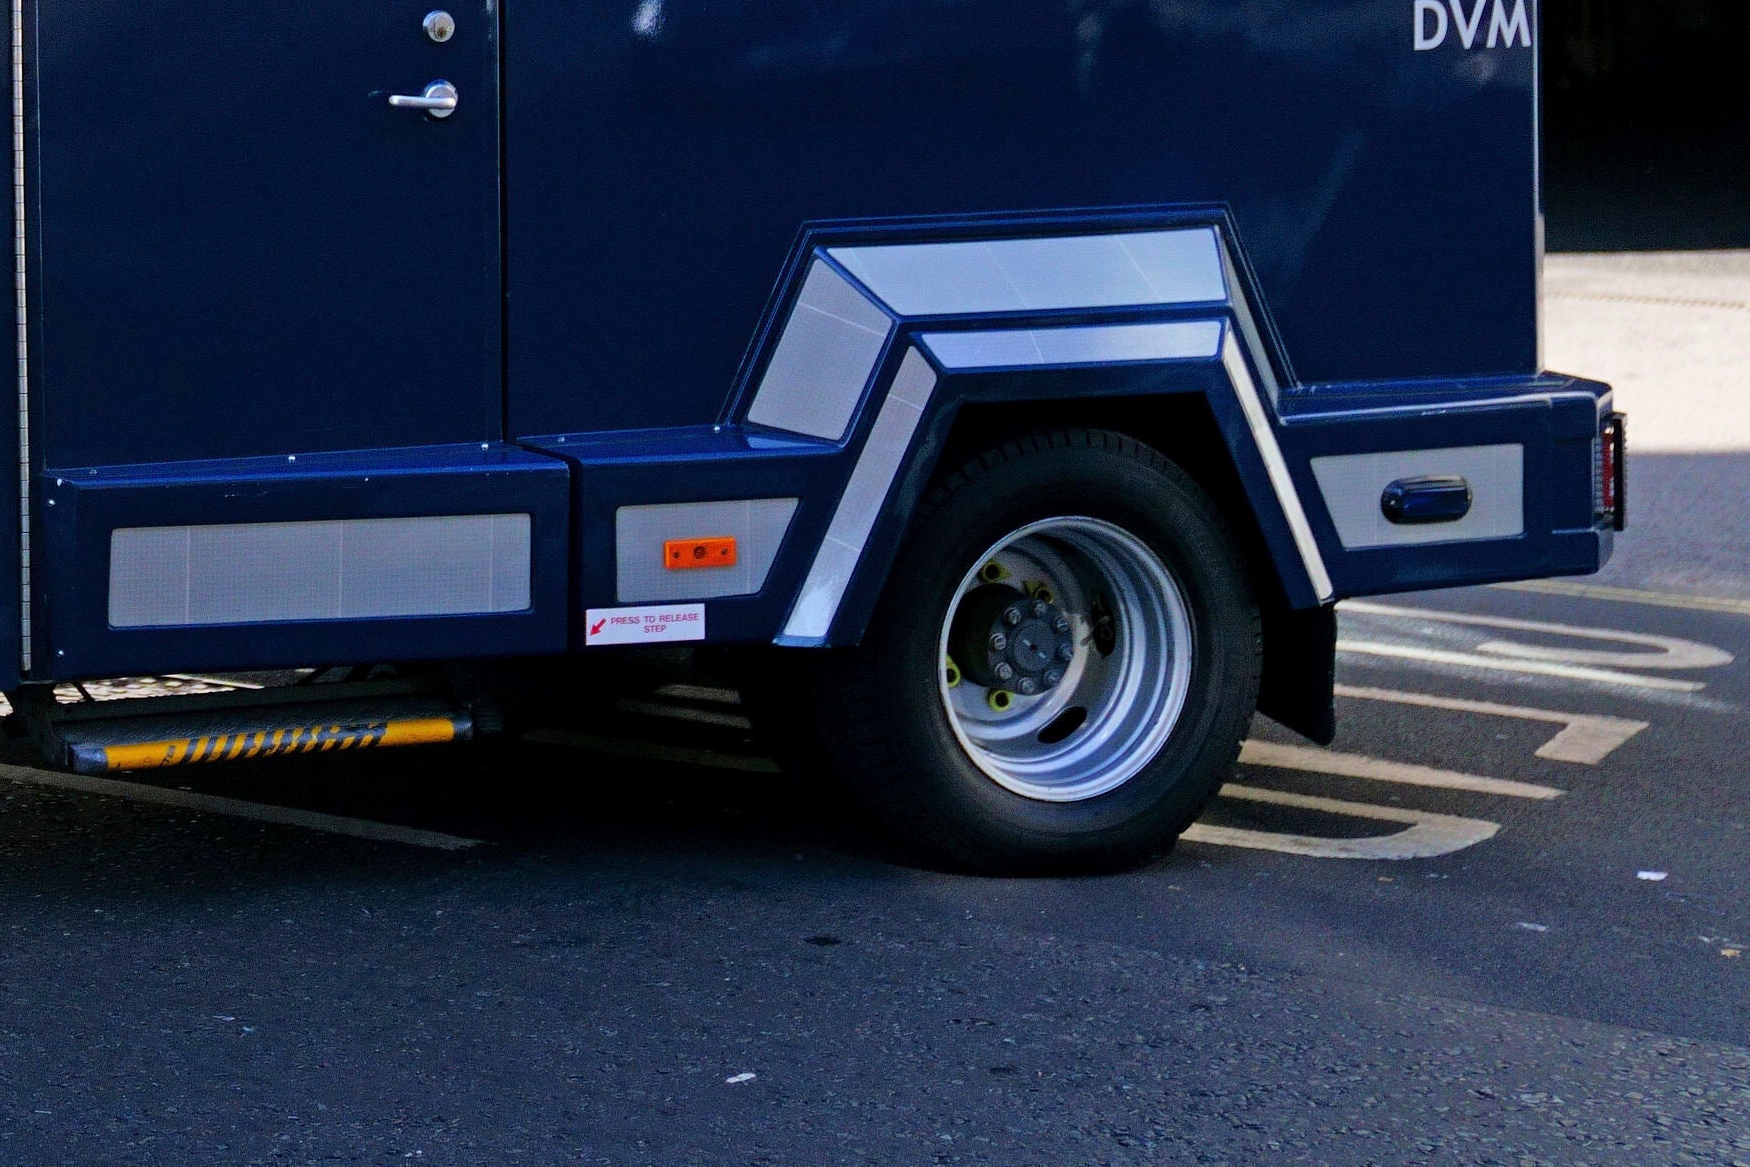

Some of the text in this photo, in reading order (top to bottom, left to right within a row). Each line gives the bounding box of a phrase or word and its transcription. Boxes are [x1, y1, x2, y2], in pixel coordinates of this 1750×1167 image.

[610, 613, 699, 625] PRESS TO RELEASE
[643, 624, 667, 633] STEP
